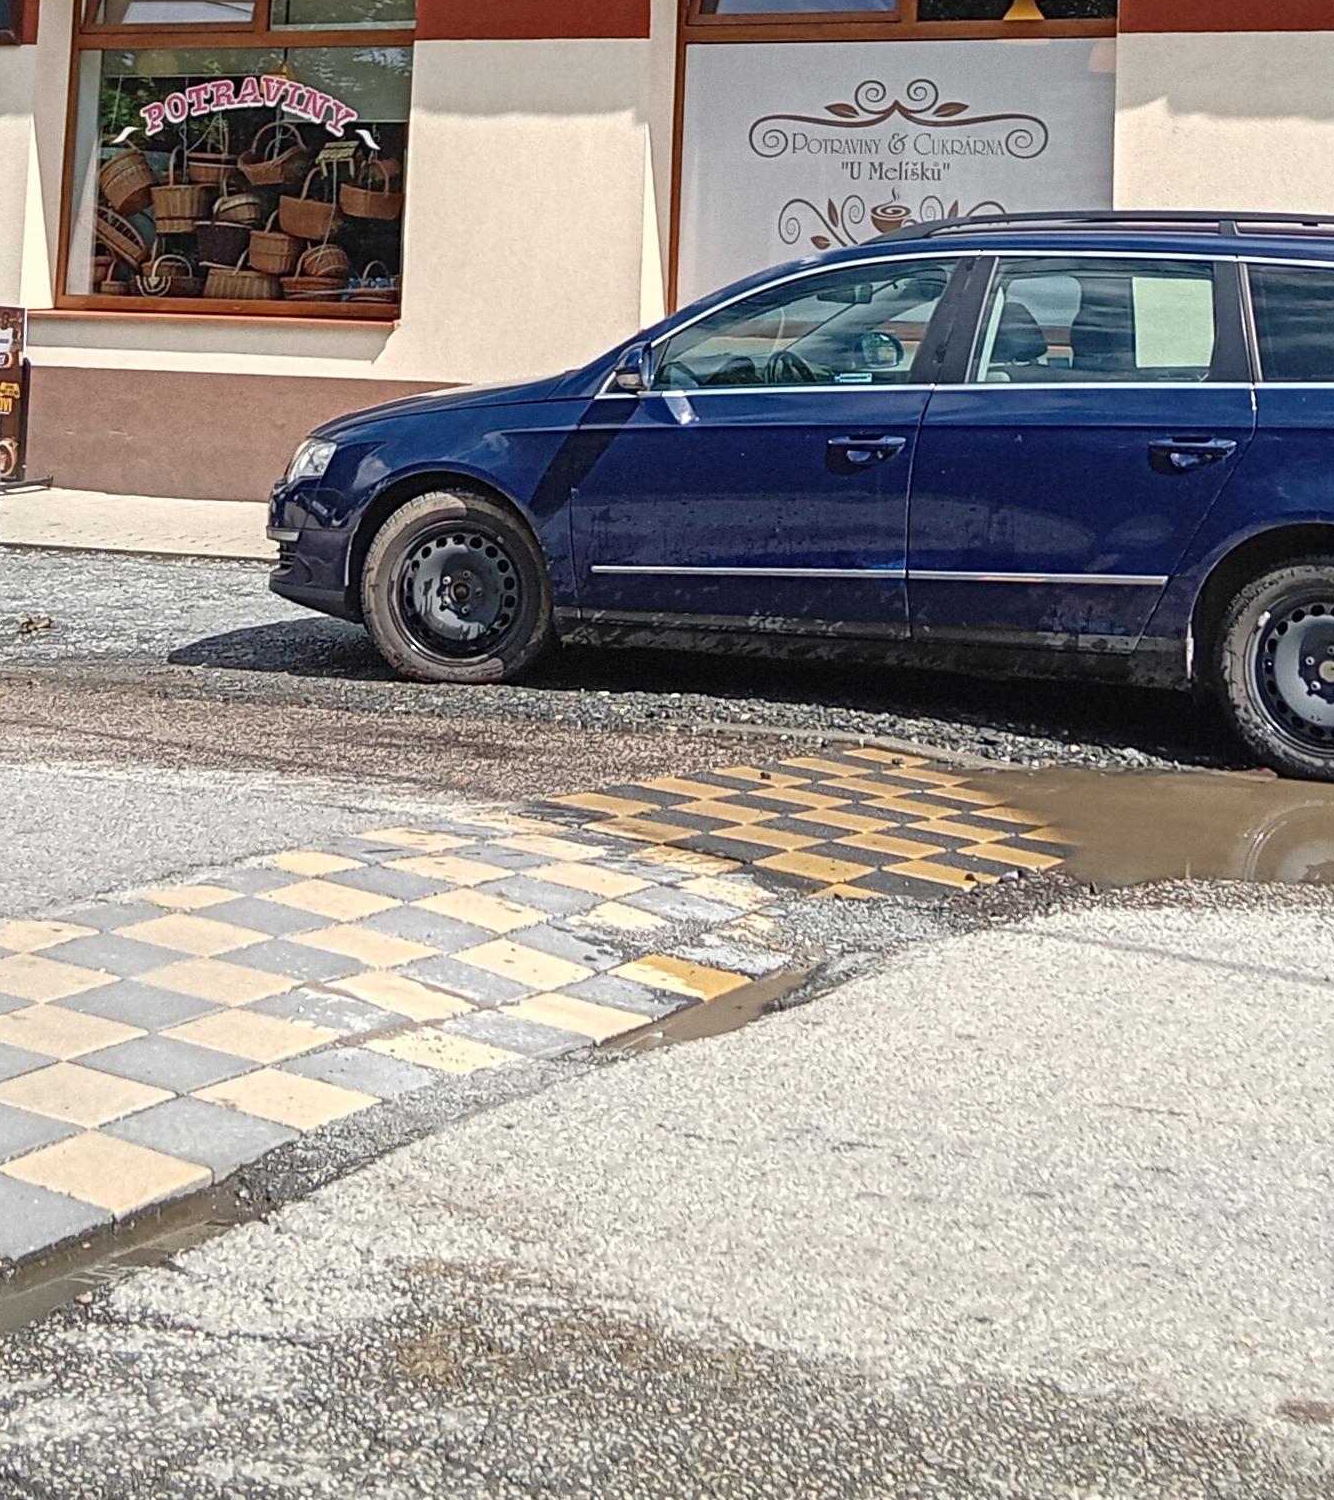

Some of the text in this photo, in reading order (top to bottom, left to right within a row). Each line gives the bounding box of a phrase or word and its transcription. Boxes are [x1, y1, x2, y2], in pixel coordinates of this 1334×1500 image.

[140, 74, 361, 137] POTRAVINY
[887, 132, 909, 156] &
[841, 161, 950, 181] "U Melíšků"
